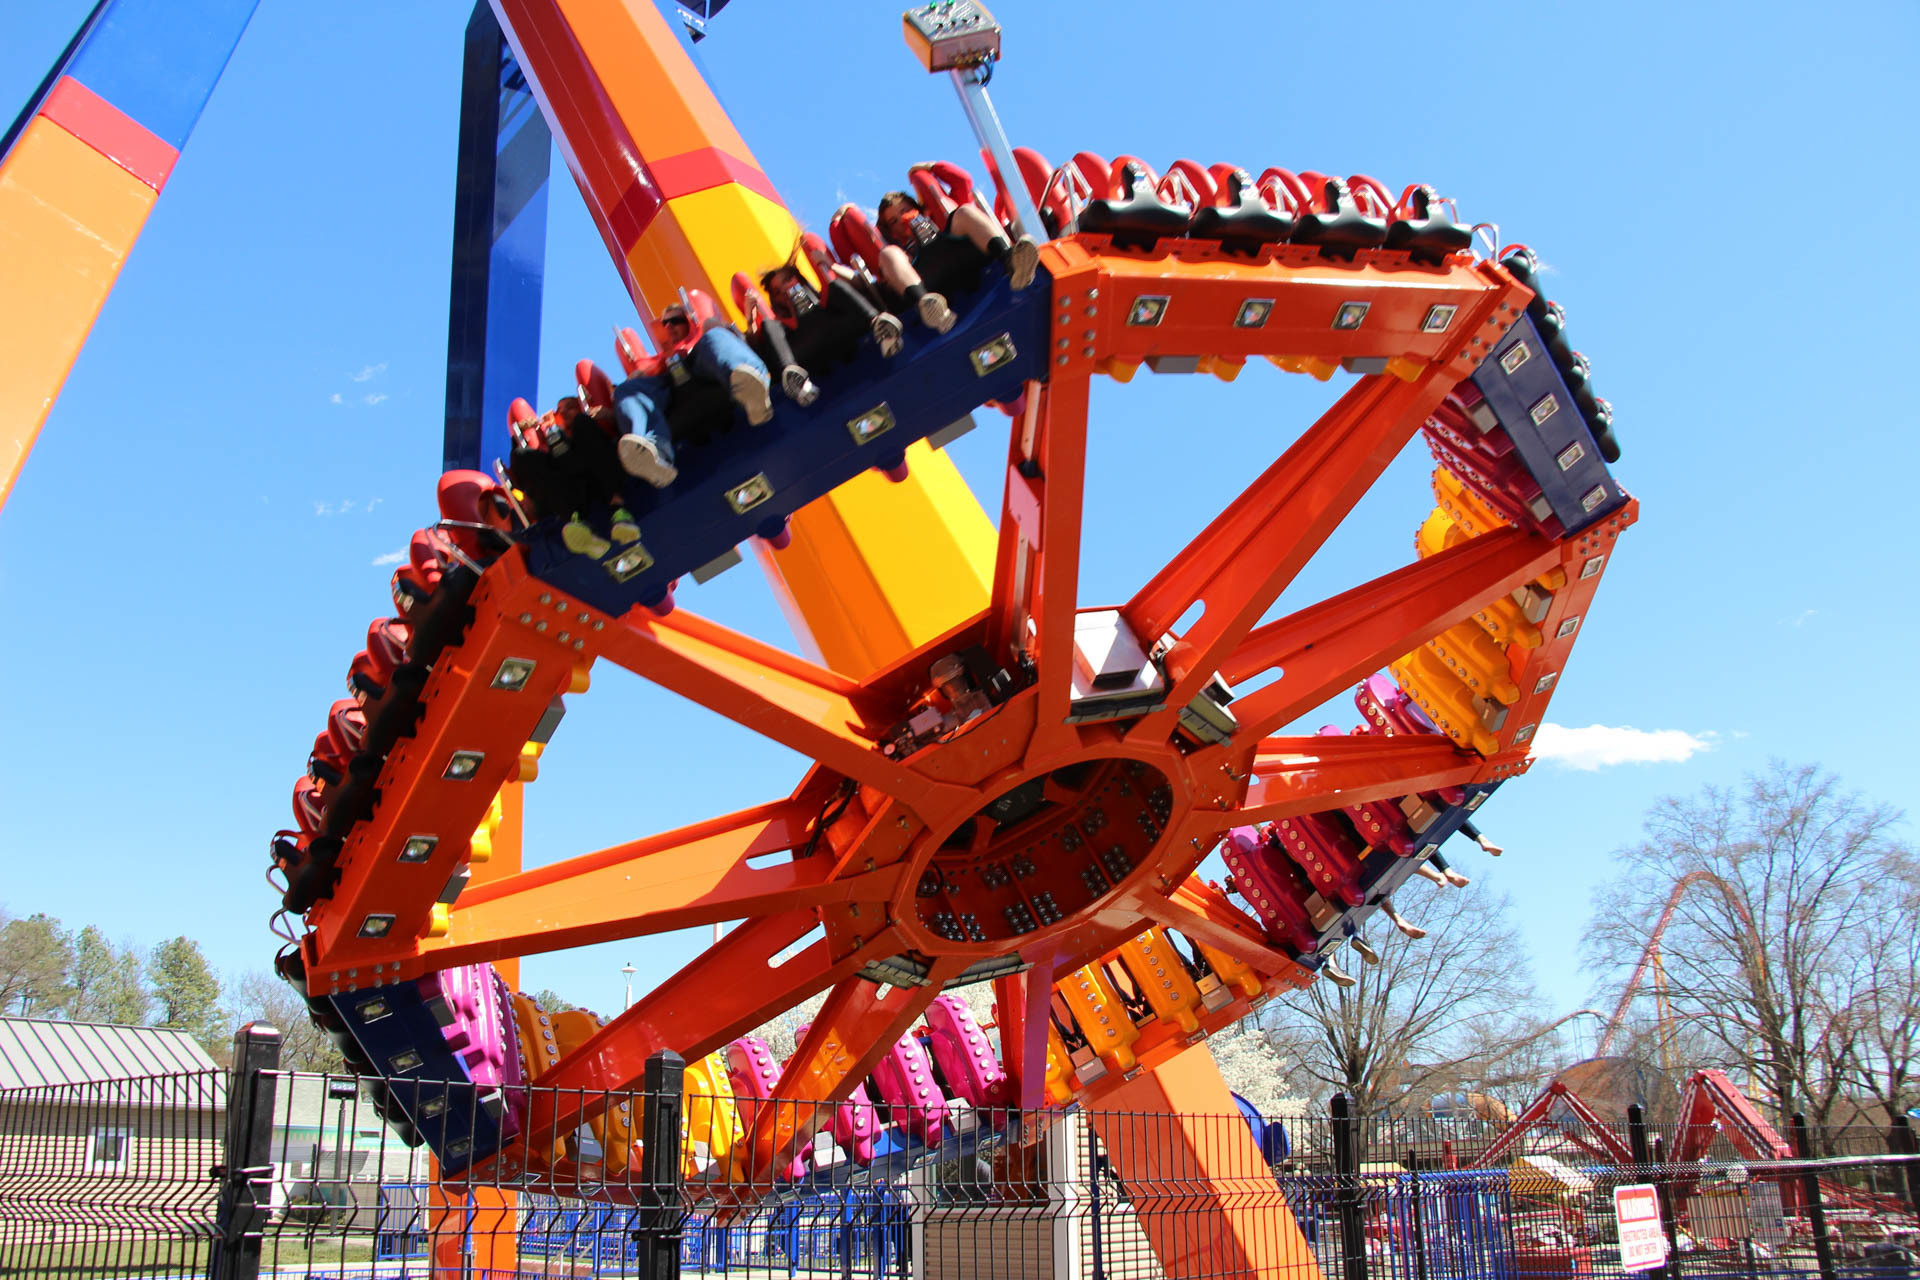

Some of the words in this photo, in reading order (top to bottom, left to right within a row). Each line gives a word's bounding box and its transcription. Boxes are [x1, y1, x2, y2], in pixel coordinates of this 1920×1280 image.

[1619, 1197, 1655, 1220] WARNING
[1623, 1229, 1648, 1242] RESTRICTED
[1649, 1227, 1659, 1238] AREA
[1629, 1246, 1635, 1257] DO
[1635, 1244, 1643, 1256] NOT
[1644, 1242, 1657, 1255] ENTER
